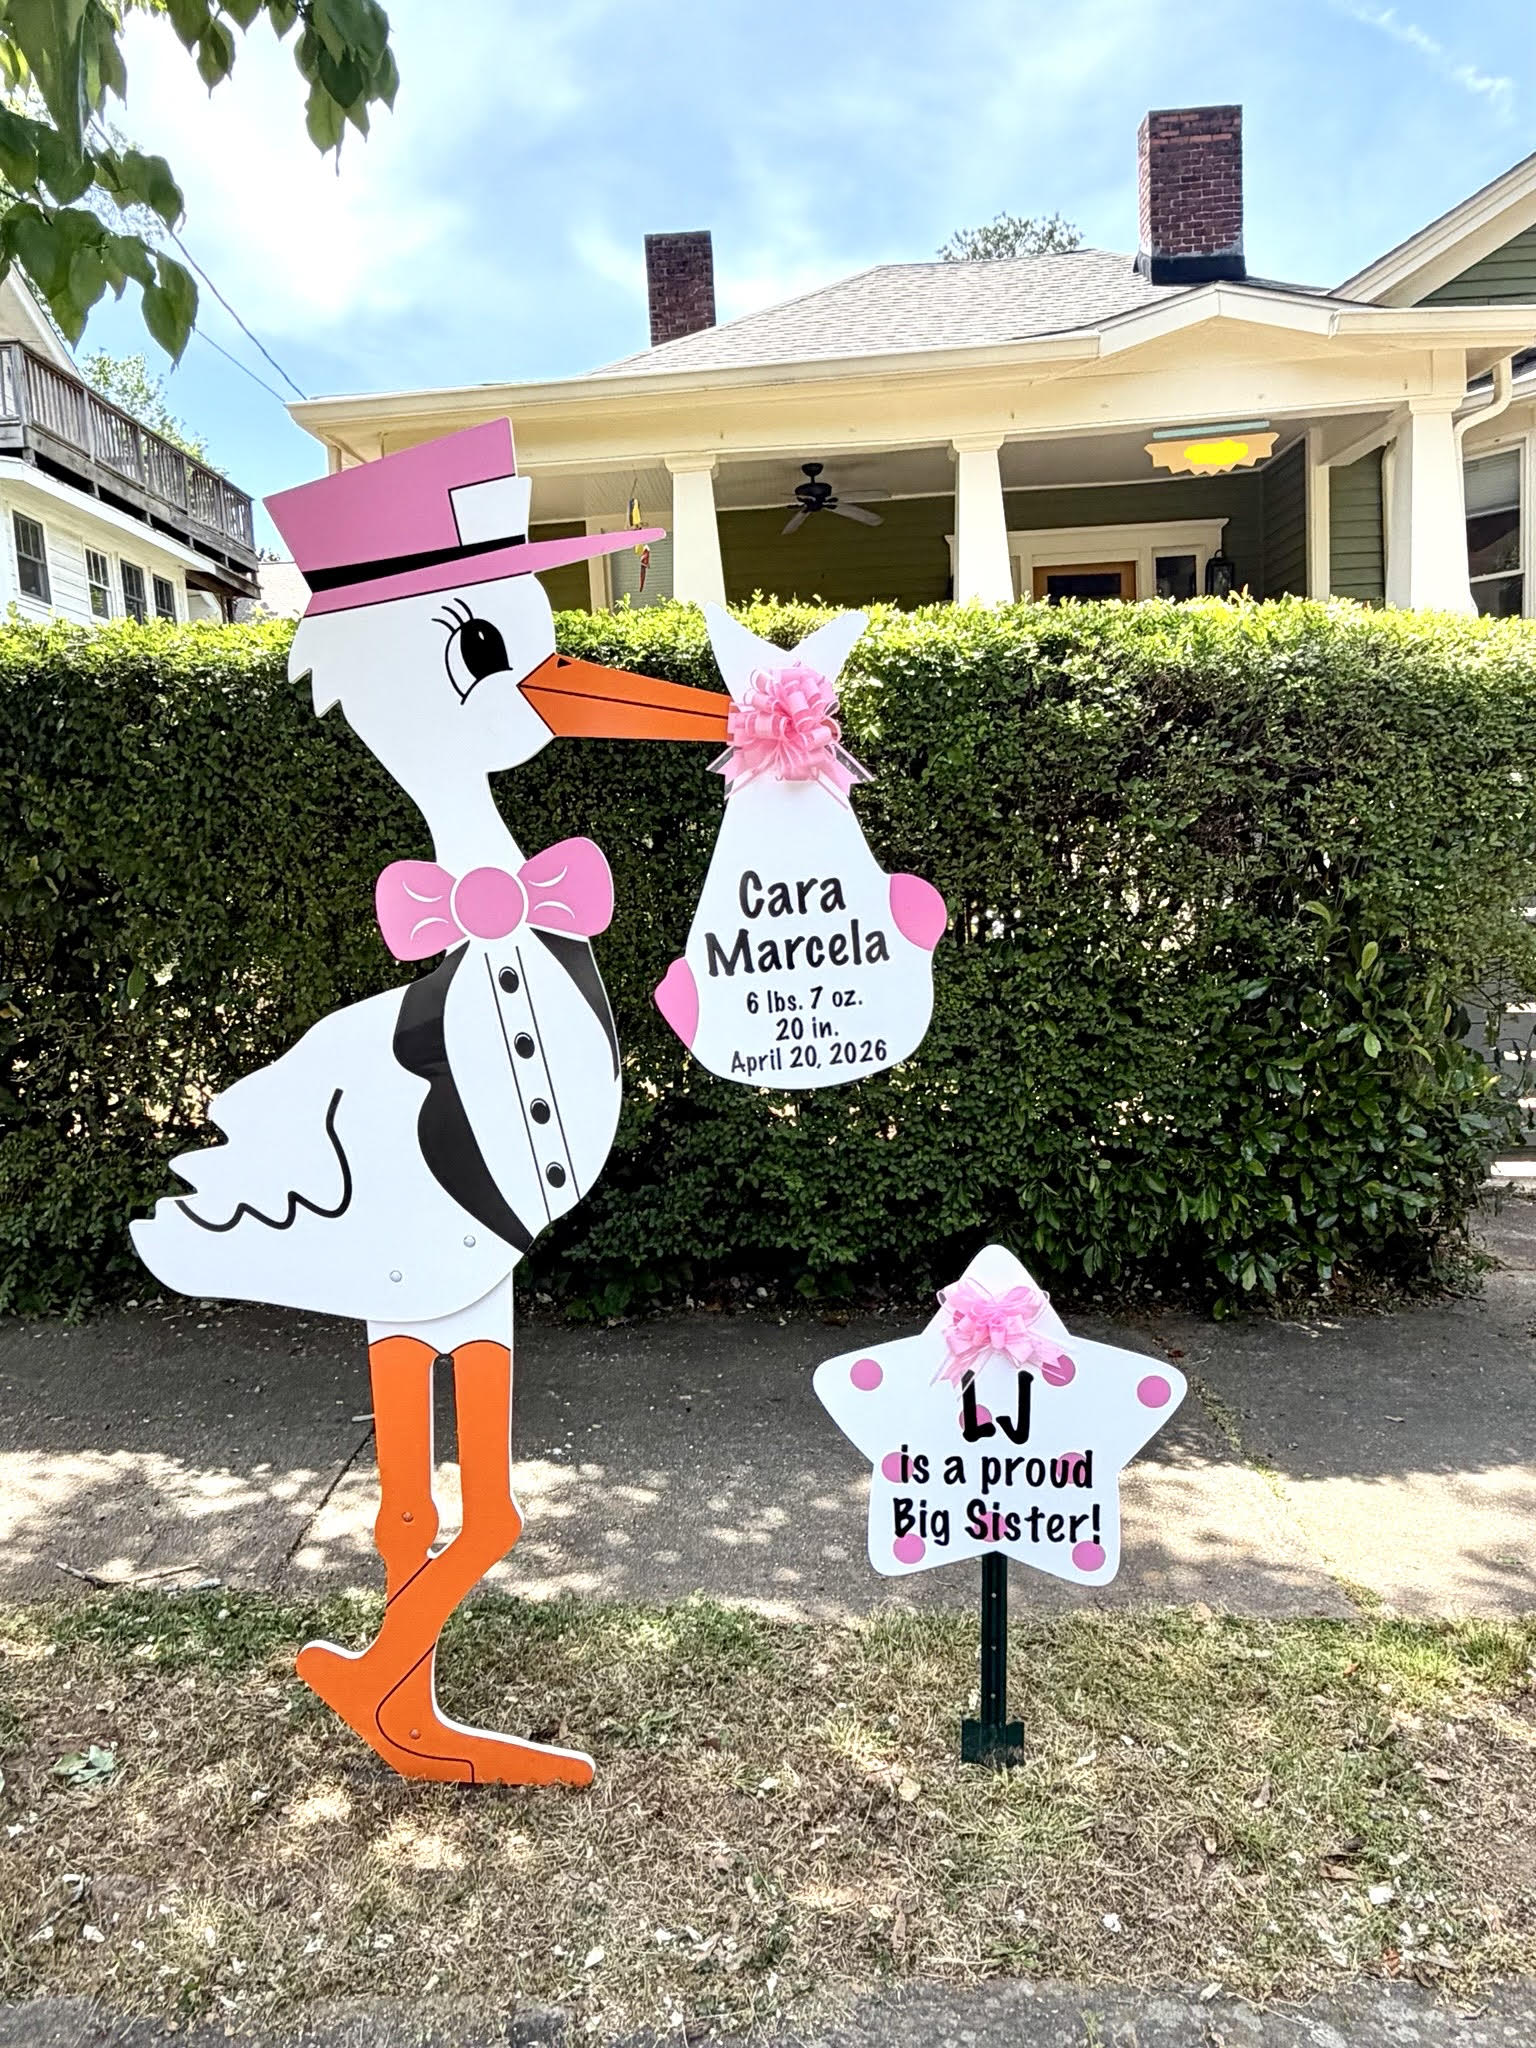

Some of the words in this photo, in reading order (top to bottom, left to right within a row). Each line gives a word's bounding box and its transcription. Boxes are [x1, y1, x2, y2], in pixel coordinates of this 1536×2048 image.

[739, 870, 846, 919] Cara
[704, 919, 890, 977] Marcela
[746, 992, 759, 1014] 6
[767, 990, 803, 1013] lbs.
[810, 985, 823, 1009] 7
[832, 989, 863, 1008] oz.
[775, 1017, 804, 1041] 20
[812, 1017, 839, 1038] in.
[731, 1048, 782, 1077] April
[790, 1045, 822, 1069] 20,
[829, 1039, 887, 1065] 2026
[961, 1369, 1034, 1445] LJ
[901, 1444, 929, 1484] is
[944, 1455, 966, 1484] a
[981, 1449, 1093, 1495] proud
[893, 1497, 950, 1546] Big
[965, 1498, 1101, 1545] Sister!
